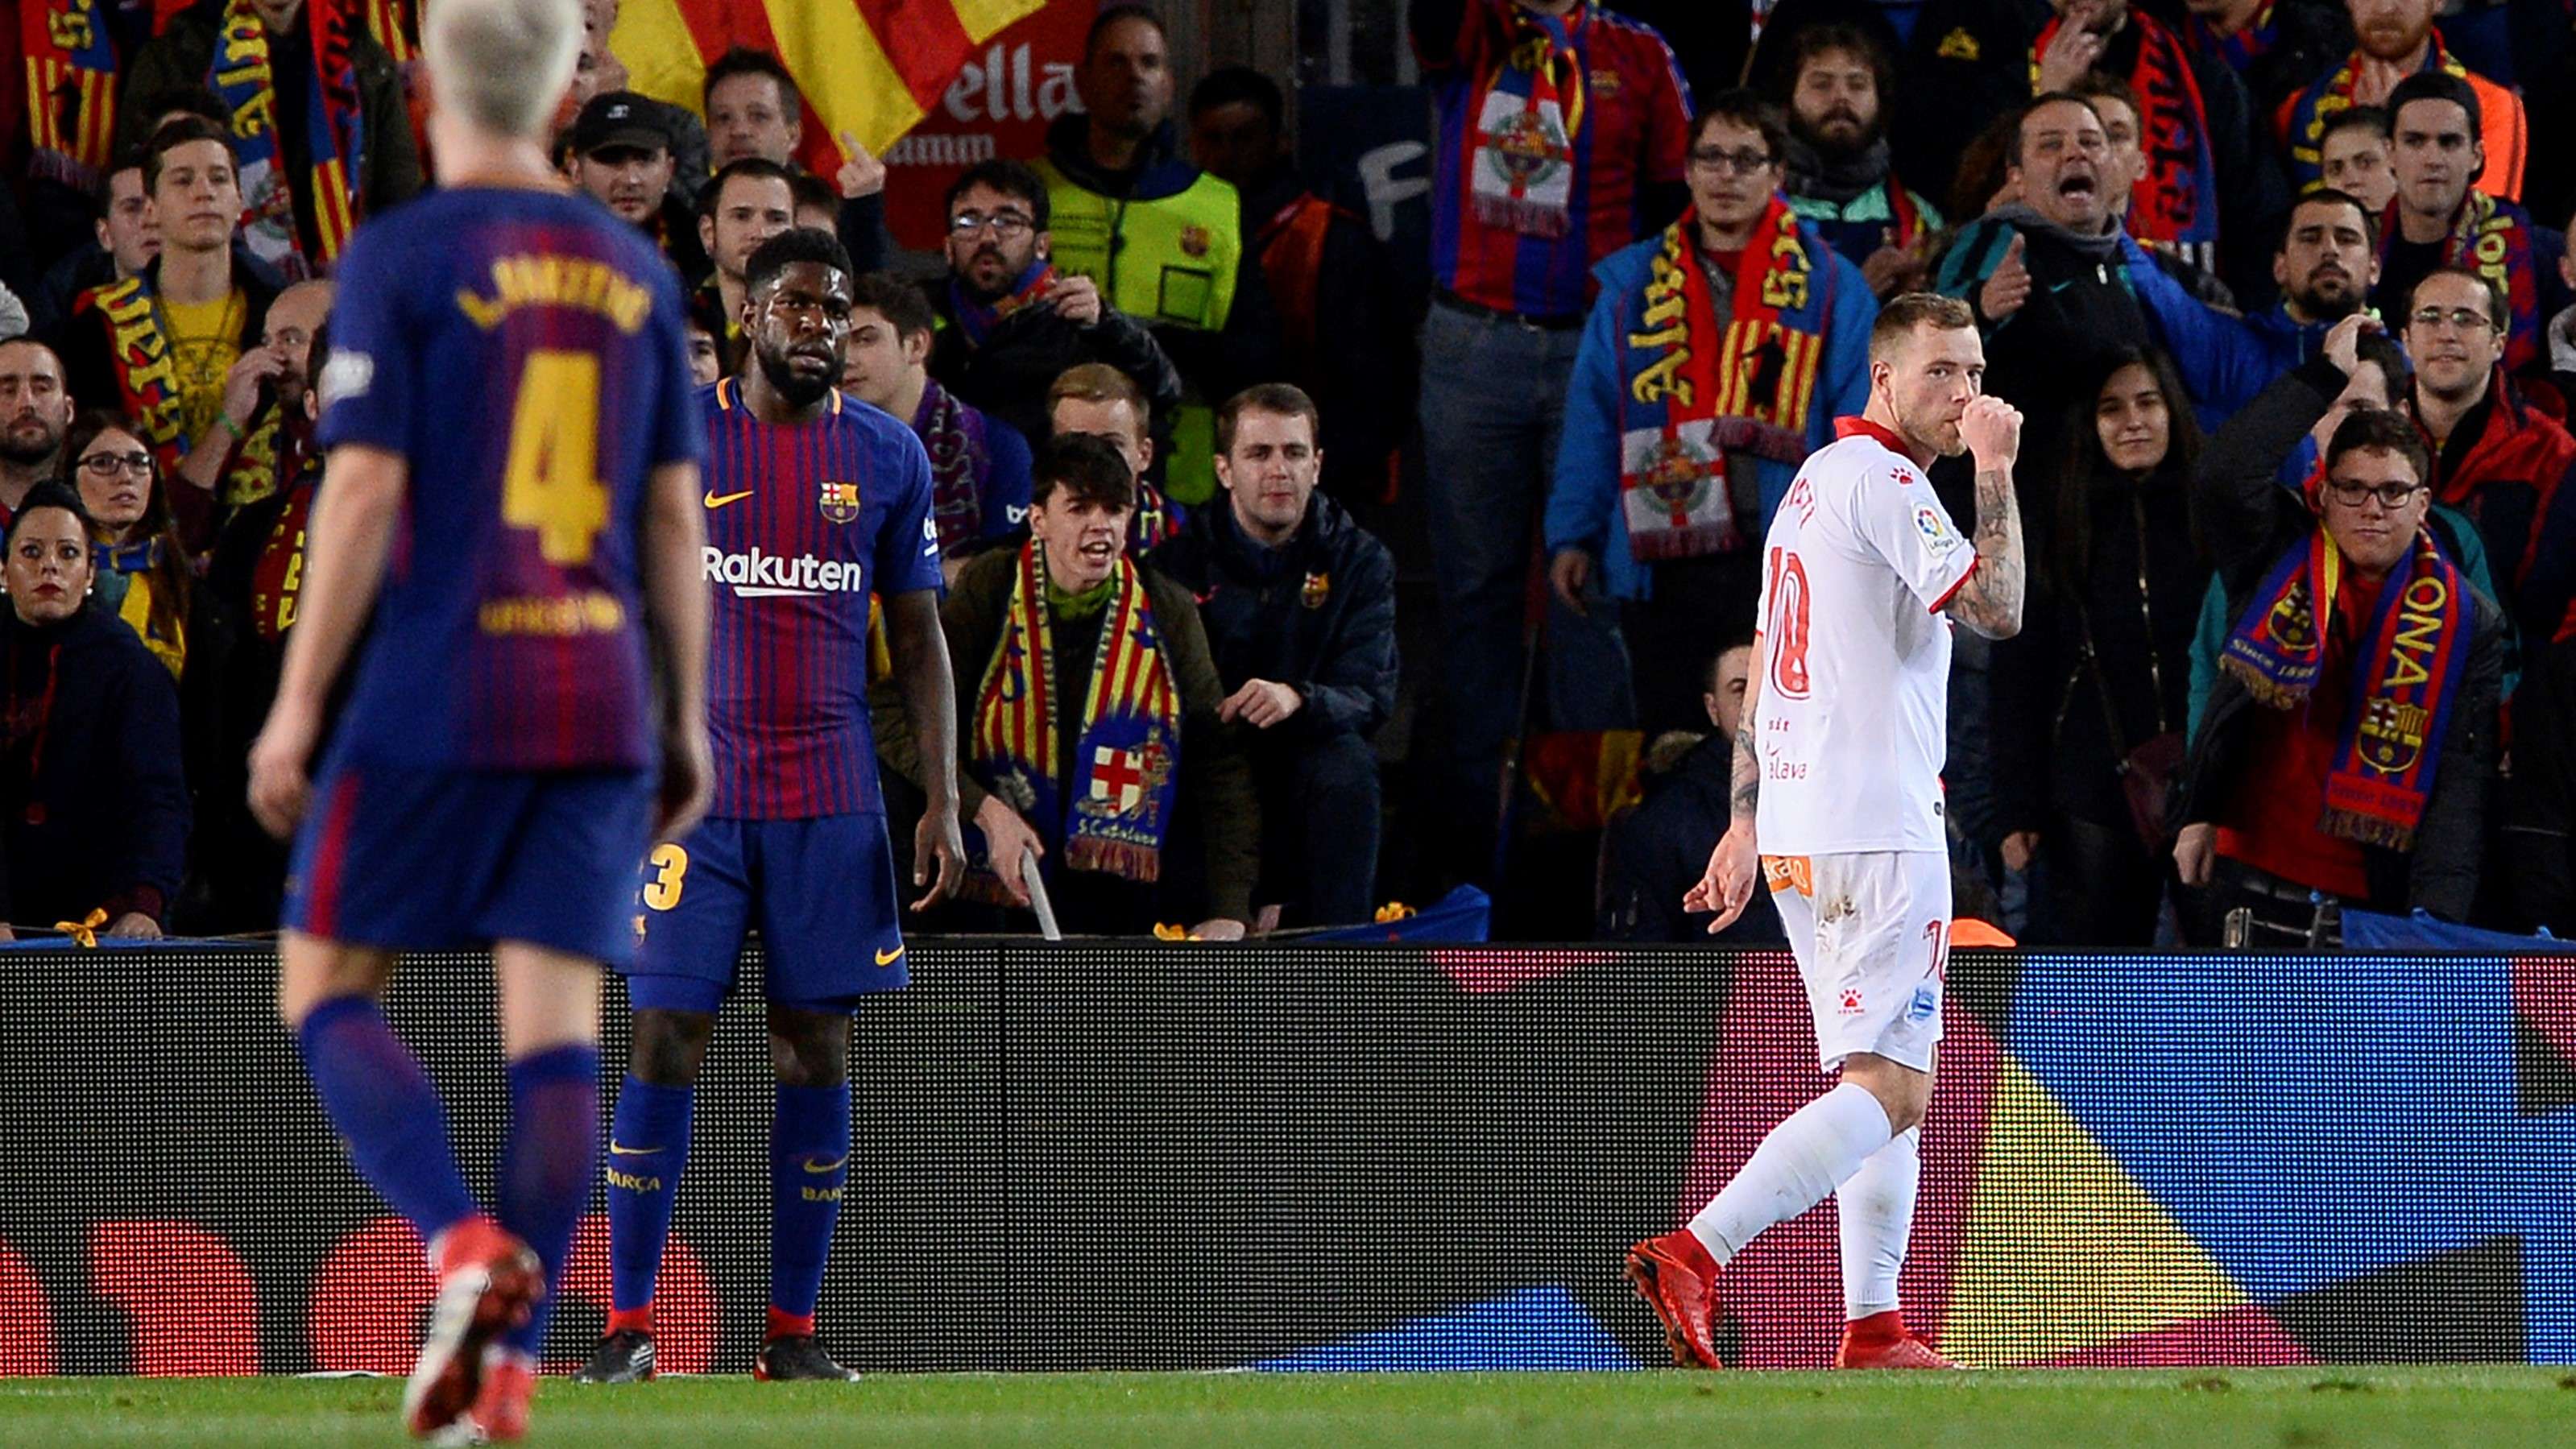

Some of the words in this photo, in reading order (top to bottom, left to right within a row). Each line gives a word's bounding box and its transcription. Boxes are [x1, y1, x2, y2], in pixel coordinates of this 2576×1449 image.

[503, 350, 610, 562] 4
[701, 546, 861, 592] Rakuten
[1766, 546, 1811, 700] 10
[2382, 562, 2447, 689] ONA
[638, 842, 688, 911] 3
